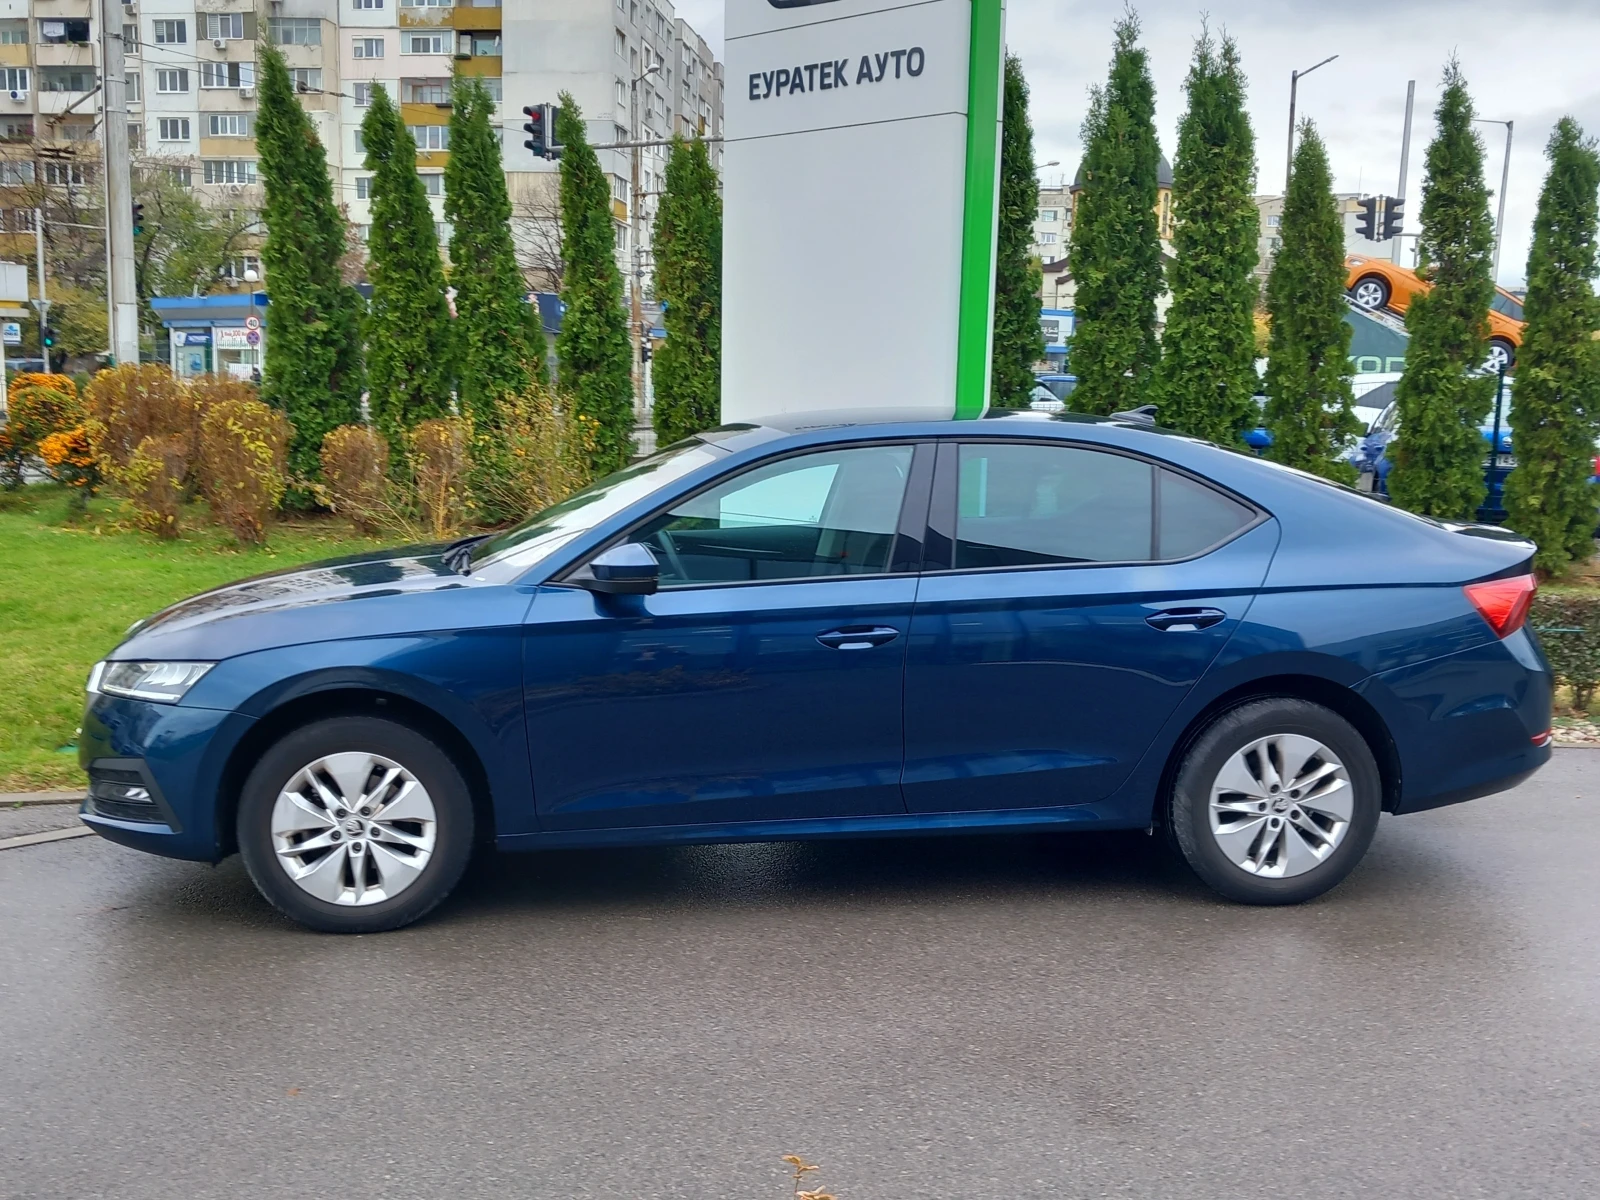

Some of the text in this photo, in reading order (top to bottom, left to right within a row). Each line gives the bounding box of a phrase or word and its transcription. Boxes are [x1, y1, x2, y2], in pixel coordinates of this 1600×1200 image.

[749, 46, 925, 101] ЕУРАТЕК АУТО
[247, 319, 258, 328] 40
